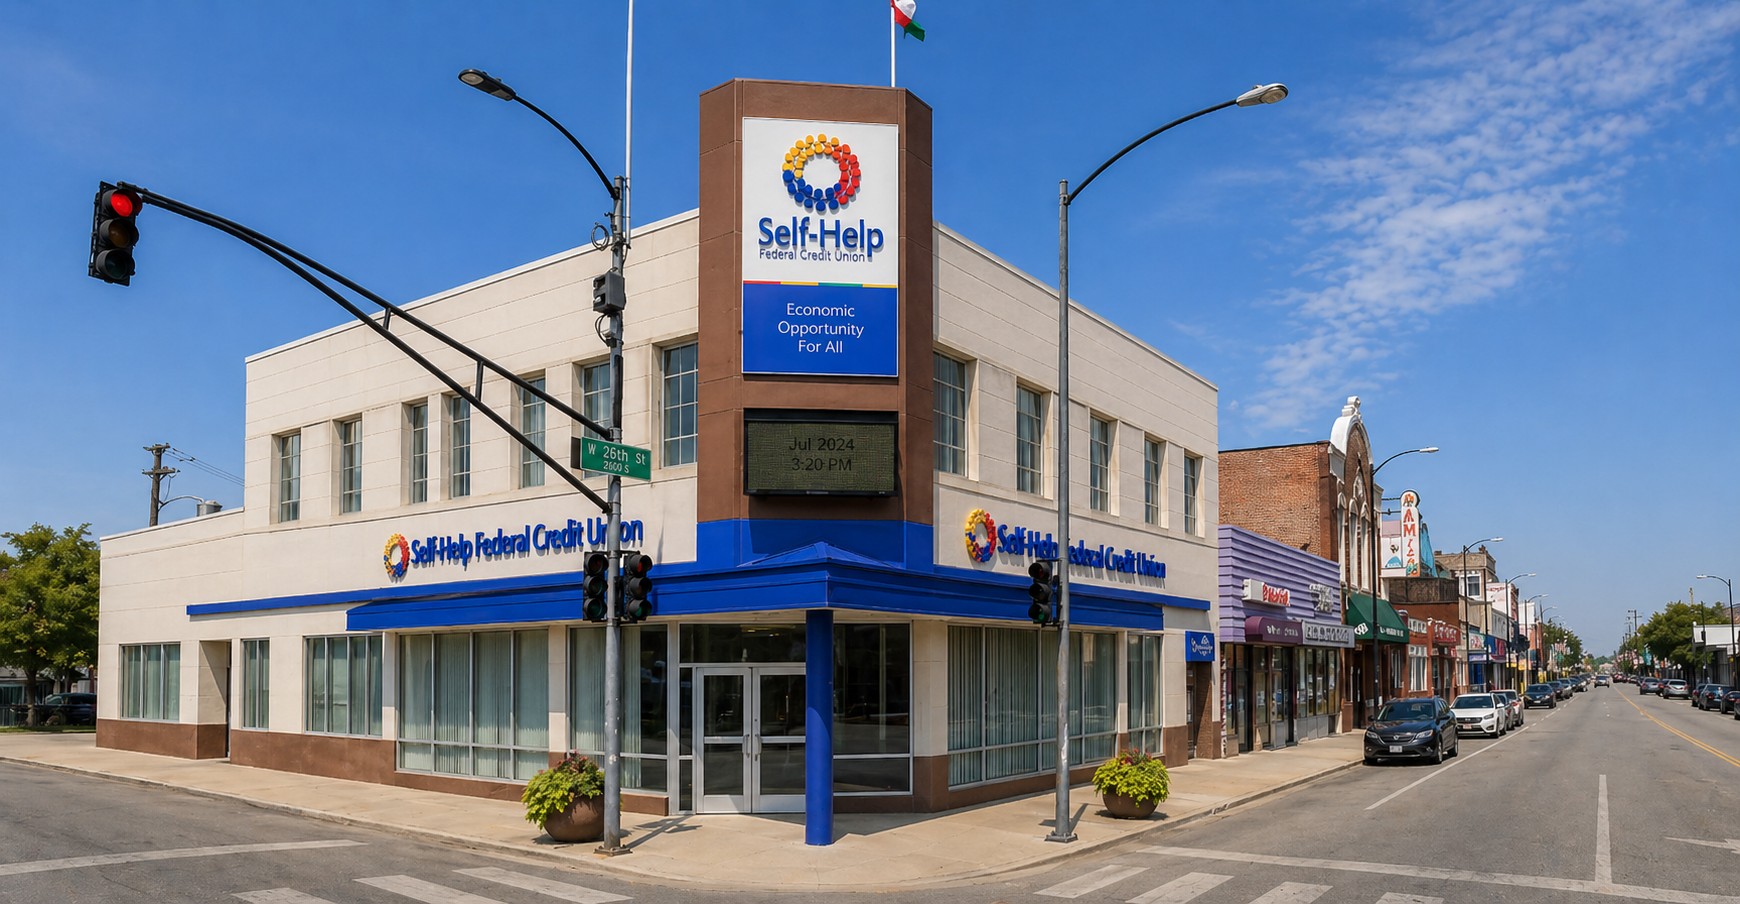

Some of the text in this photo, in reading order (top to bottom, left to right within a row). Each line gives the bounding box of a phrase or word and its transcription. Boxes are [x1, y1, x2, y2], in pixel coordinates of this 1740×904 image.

[758, 216, 884, 258] Self-Help
[759, 248, 866, 263] Federal Credit Union
[786, 302, 856, 318] Economic
[777, 320, 865, 339] Opportunity
[798, 340, 843, 354] For All
[788, 437, 855, 451] Jul 2024
[587, 442, 646, 466] W 26th St
[603, 460, 630, 474] 2600 S
[791, 457, 853, 472] 3:20 PM
[411, 517, 643, 567] Self-Help Federal Credit Unon
[1068, 539, 1104, 569] ederal
